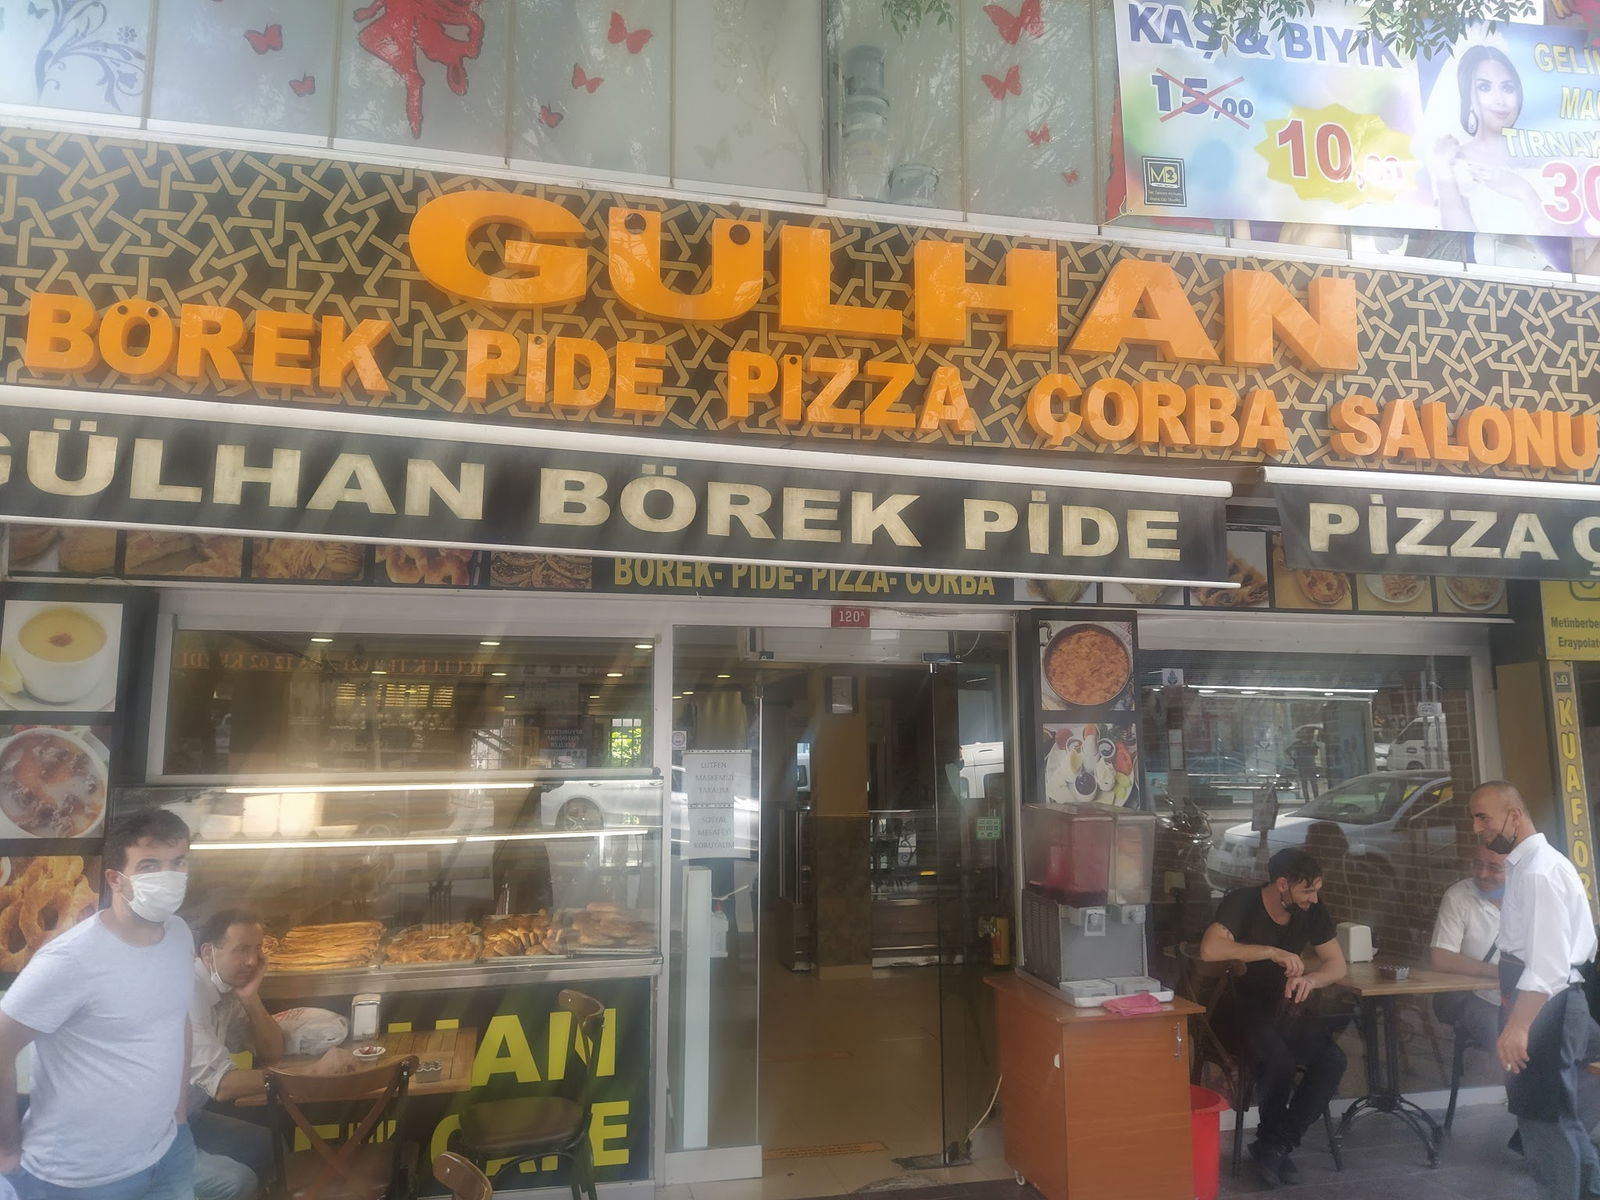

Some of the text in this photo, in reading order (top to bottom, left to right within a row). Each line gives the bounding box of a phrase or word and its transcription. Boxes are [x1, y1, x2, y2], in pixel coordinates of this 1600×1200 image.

[1129, 4, 1221, 58] KAŞ
[1284, 22, 1402, 68] BIYIK
[409, 190, 1359, 373] GÜLHAN
[24, 292, 1598, 470] BÖREK PİDE PİZZA ÇORBA SALONU
[538, 463, 922, 548] BÖREK
[963, 490, 1181, 561] PİDE
[1309, 493, 1560, 561] PİZZA
